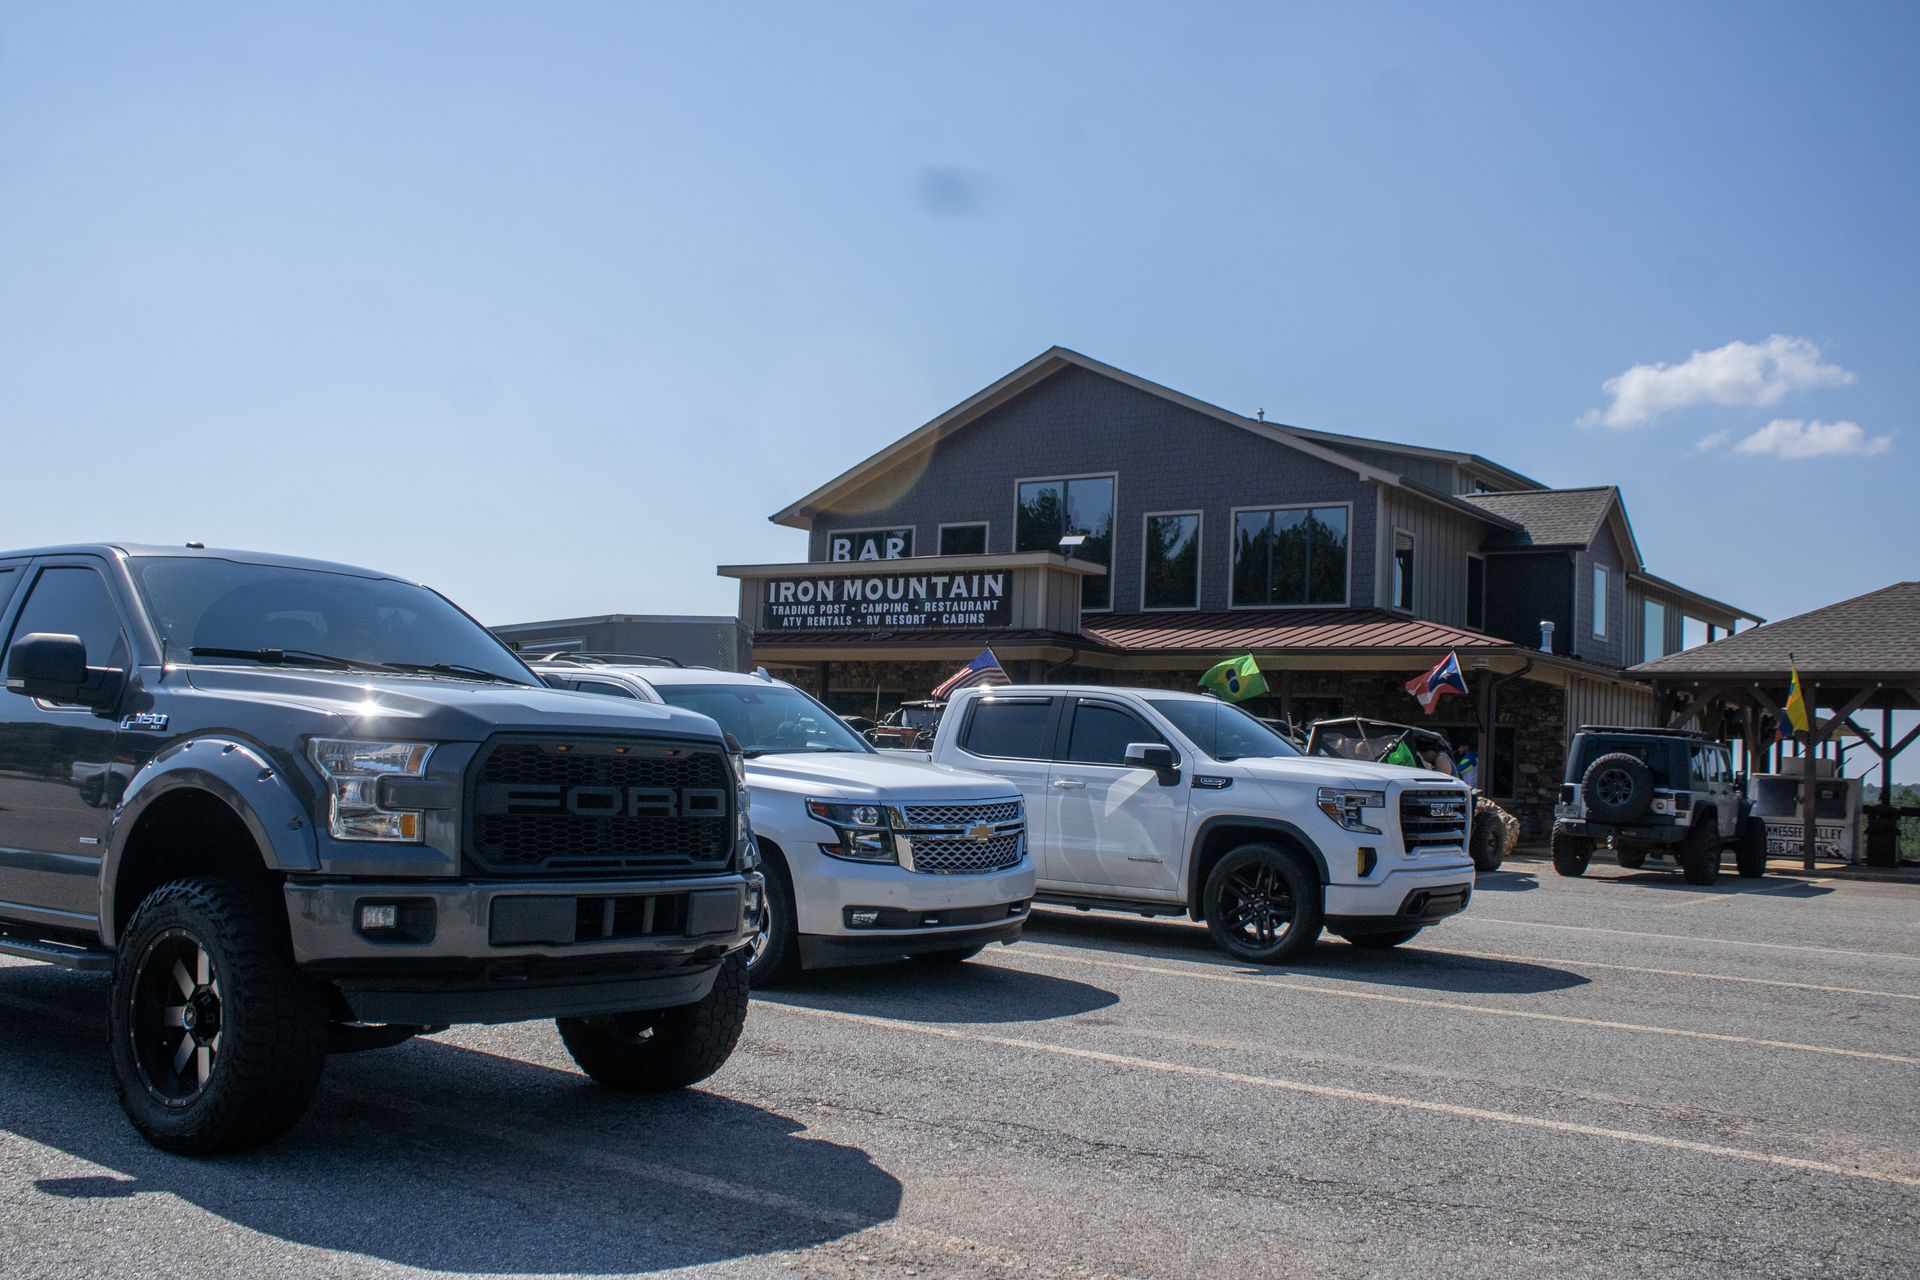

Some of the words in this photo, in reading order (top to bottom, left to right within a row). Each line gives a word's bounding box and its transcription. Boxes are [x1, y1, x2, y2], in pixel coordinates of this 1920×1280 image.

[832, 538, 905, 562] BAR
[769, 580, 834, 603] IRON
[843, 574, 1004, 601] MOUNTAIN
[772, 604, 815, 615] TRADING
[820, 604, 846, 614] POST
[861, 602, 909, 613] CAMPING
[924, 600, 999, 612] RESTAURANT
[782, 616, 802, 627] ATV
[807, 615, 852, 627] RENTALS
[867, 615, 880, 625] RV
[885, 614, 927, 625] RESORT
[942, 613, 985, 624] CABINS
[499, 784, 726, 817] FORD
[1814, 828, 1842, 839] ALLEY
